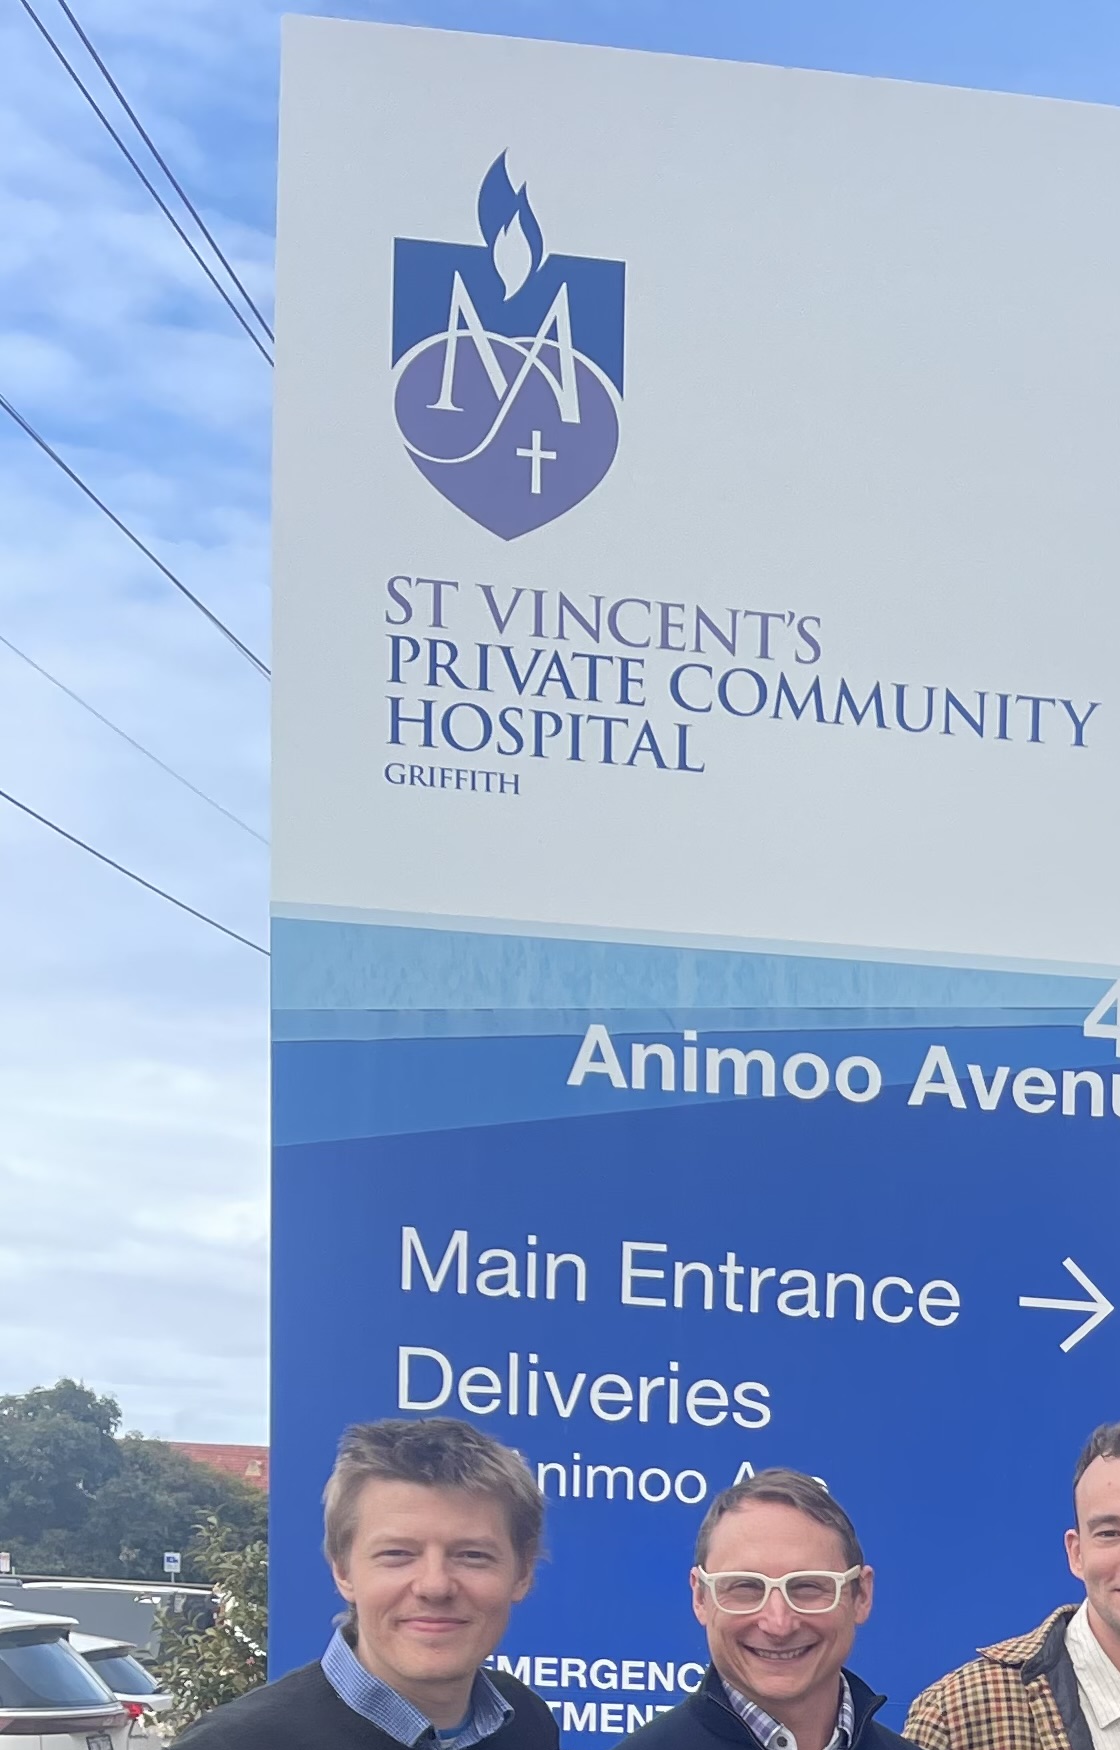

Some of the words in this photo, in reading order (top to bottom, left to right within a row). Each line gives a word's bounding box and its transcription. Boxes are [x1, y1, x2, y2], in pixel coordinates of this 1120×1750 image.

[384, 574, 459, 630] ST
[475, 582, 822, 666] VINCENT'S
[385, 633, 647, 707] PRIVATE
[668, 662, 1103, 749] COMMUNITY
[384, 695, 706, 773] HOSPITAL
[384, 762, 521, 796] GRIFFITH
[567, 1024, 883, 1103] Animoo
[401, 1226, 587, 1302] Main
[621, 1241, 962, 1328] Entrance
[398, 1346, 772, 1430] Deliveries
[511, 1449, 707, 1504] nimoo
[484, 1654, 711, 1693] MERGENC
